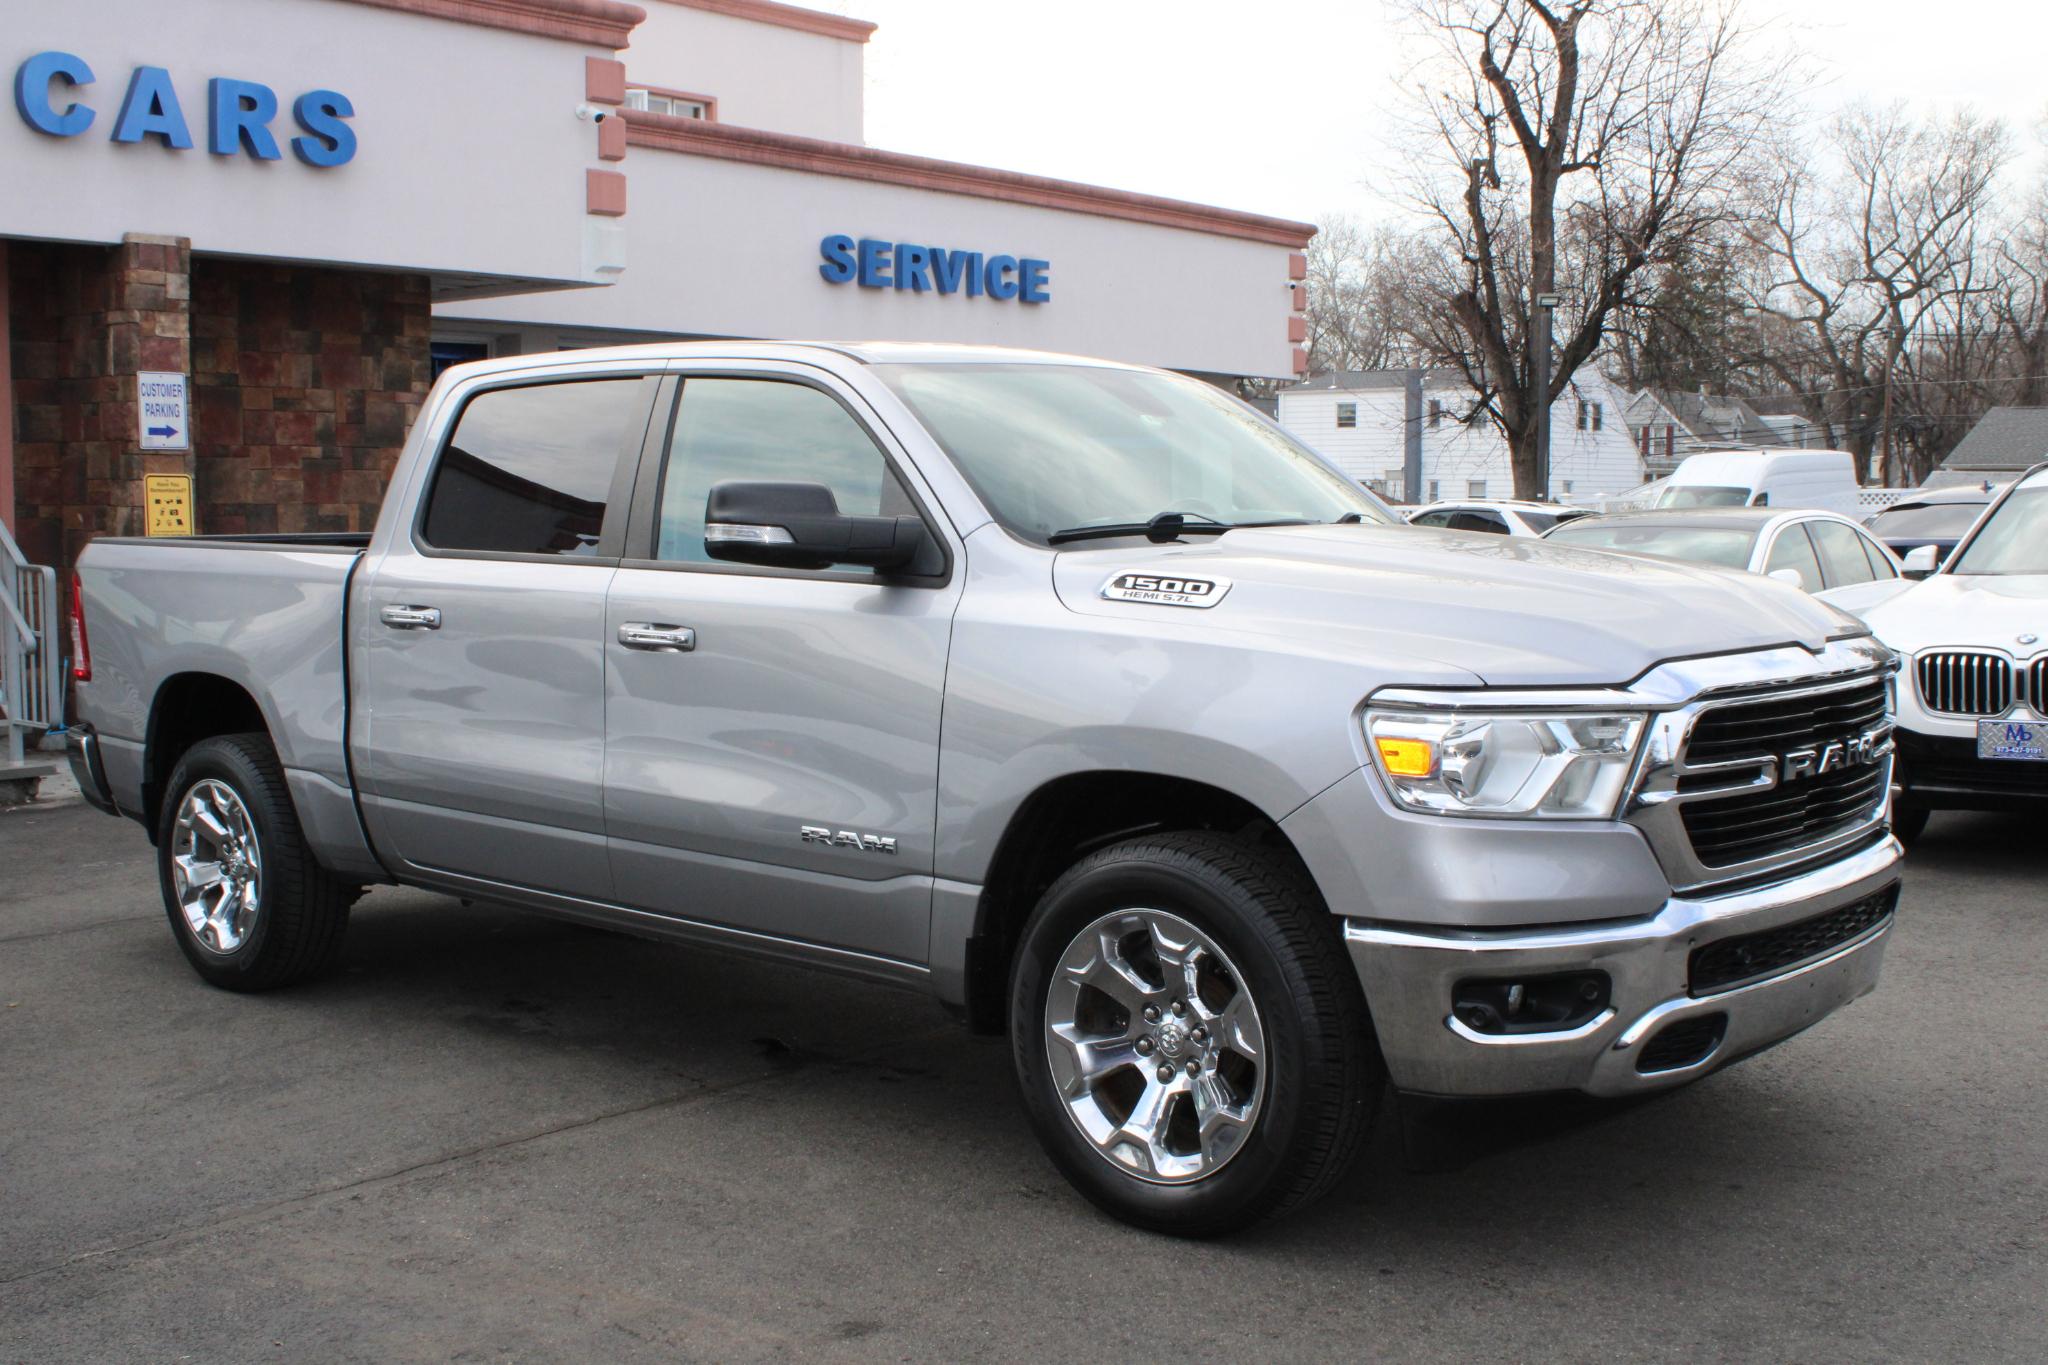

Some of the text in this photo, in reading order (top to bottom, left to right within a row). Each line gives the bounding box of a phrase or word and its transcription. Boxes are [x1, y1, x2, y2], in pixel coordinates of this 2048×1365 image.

[14, 50, 358, 168] CARS
[819, 234, 1051, 303] SERVICE
[141, 382, 183, 397] CUSTOMER
[145, 403, 180, 418] PARKING
[1122, 576, 1210, 595] 1500
[1122, 590, 1193, 603] HEMI 5.7L
[1783, 732, 1876, 781] RAM
[800, 825, 898, 855] RAM
